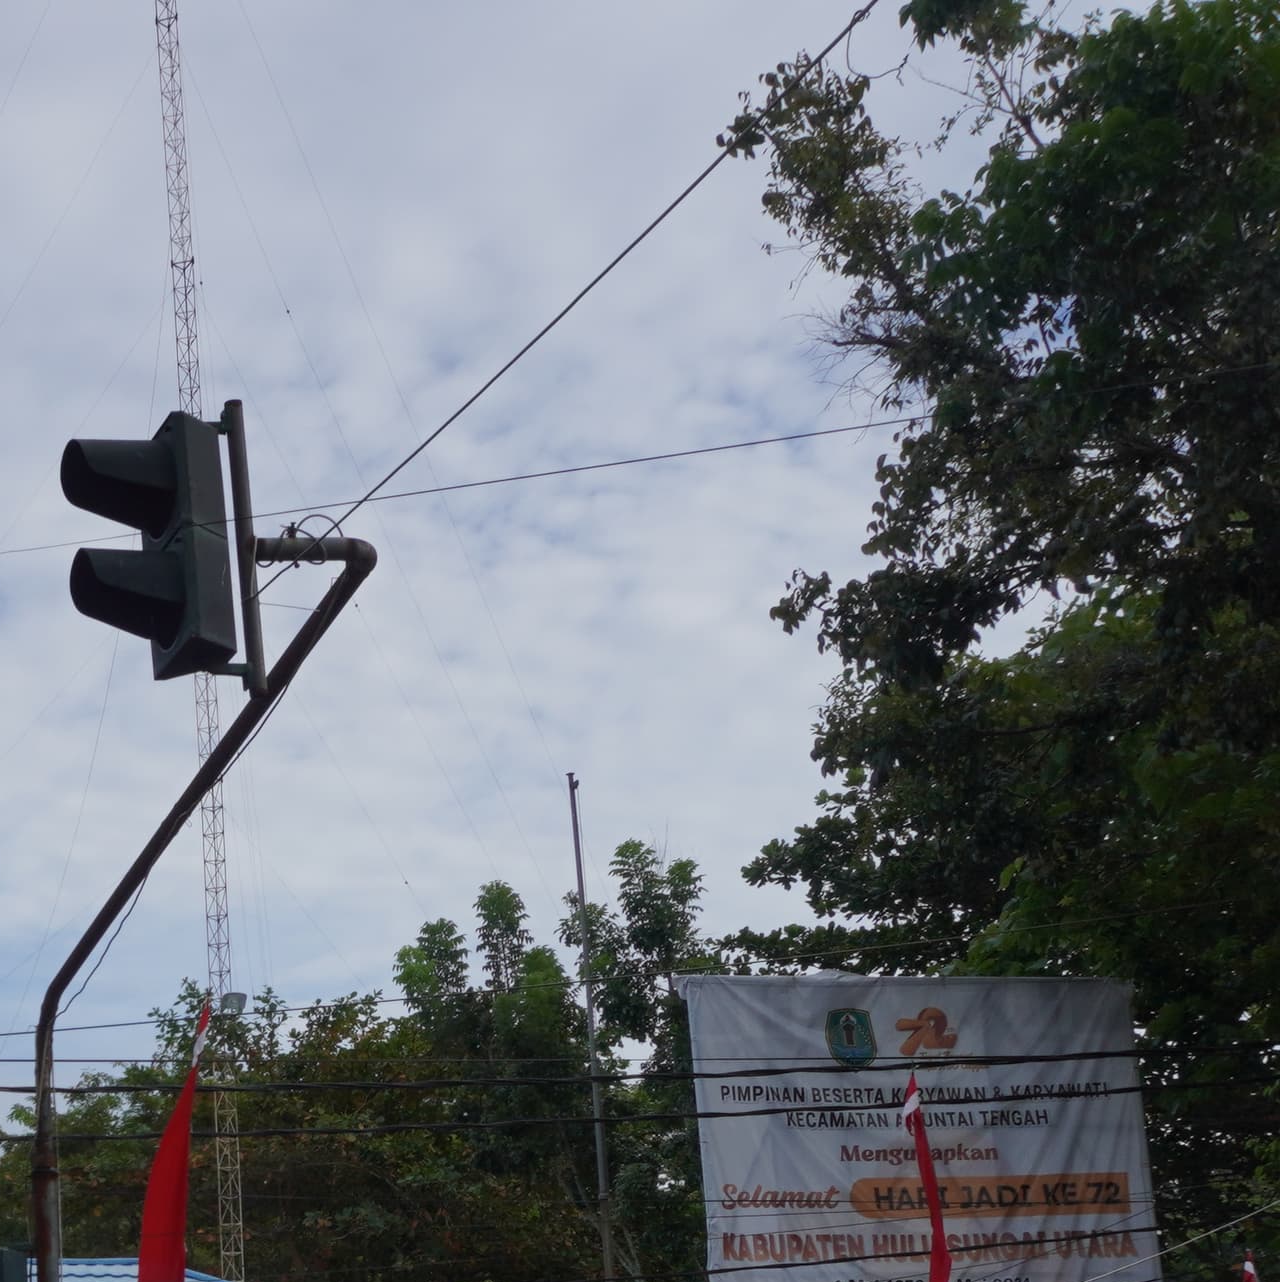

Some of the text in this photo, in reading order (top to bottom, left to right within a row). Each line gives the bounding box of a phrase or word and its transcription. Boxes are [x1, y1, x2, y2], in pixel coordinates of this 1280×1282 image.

[720, 1085, 805, 1104] PIMPINAN
[813, 1087, 885, 1104] BESERTA
[892, 1085, 985, 1104] KRYAWAN
[786, 1111, 889, 1128] KECAMATAN
[979, 1109, 1049, 1127] TENGAH
[840, 1143, 999, 1166] Menguapkan
[721, 1183, 840, 1210] Selamat
[959, 1183, 1032, 1209] JADI
[1042, 1182, 1077, 1206] KE
[1086, 1180, 1122, 1204] 72
[722, 1232, 865, 1263] KABUPATEN
[946, 1231, 1046, 1262] SUNGAI
[1053, 1229, 1138, 1259] UTARA
